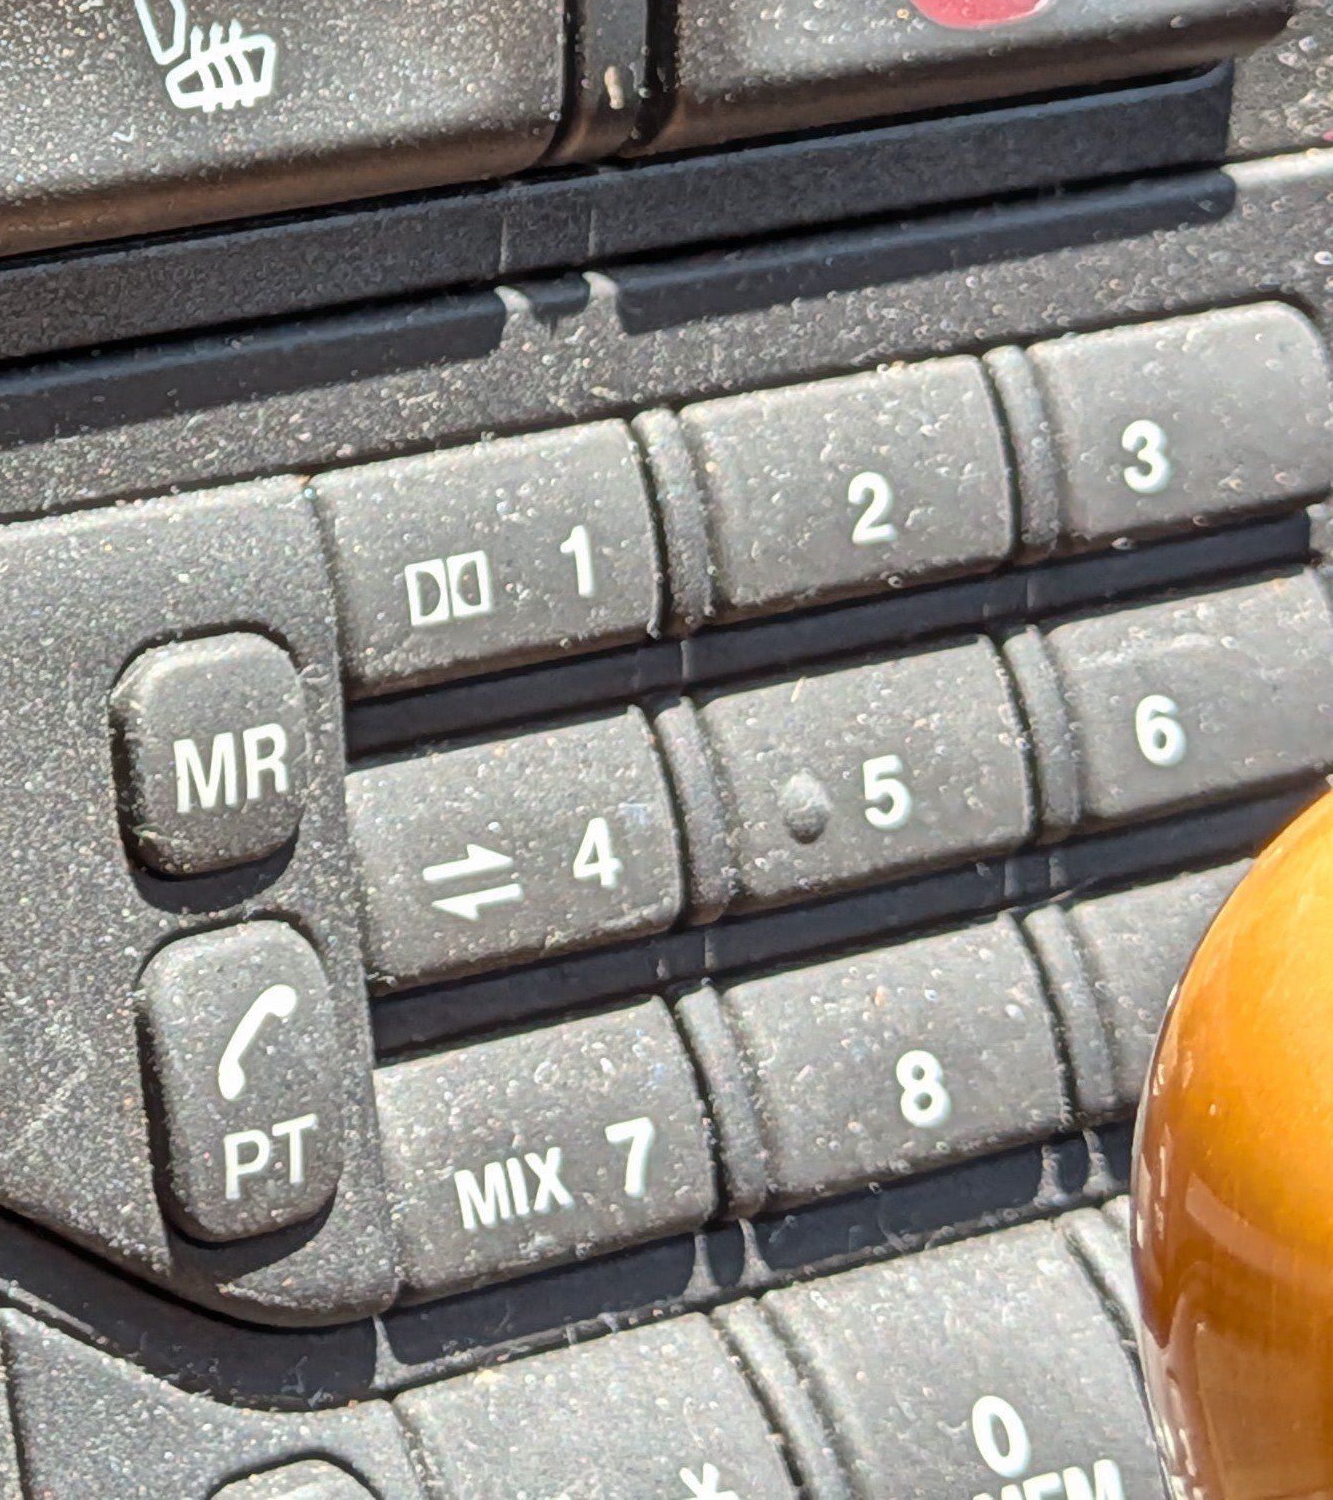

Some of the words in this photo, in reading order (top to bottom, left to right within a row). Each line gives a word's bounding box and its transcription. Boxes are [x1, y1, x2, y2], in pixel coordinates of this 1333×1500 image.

[1121, 419, 1170, 493] 3
[847, 471, 896, 544] 2
[559, 524, 595, 598] 1
[1135, 694, 1184, 765] 6
[173, 722, 289, 813] MR
[862, 754, 912, 829] 5
[573, 816, 623, 888] 4
[895, 1049, 950, 1128] 8
[223, 1113, 318, 1200] PT
[453, 1146, 573, 1231] MIX
[605, 1116, 656, 1198] 7
[971, 1395, 1031, 1478] 0
